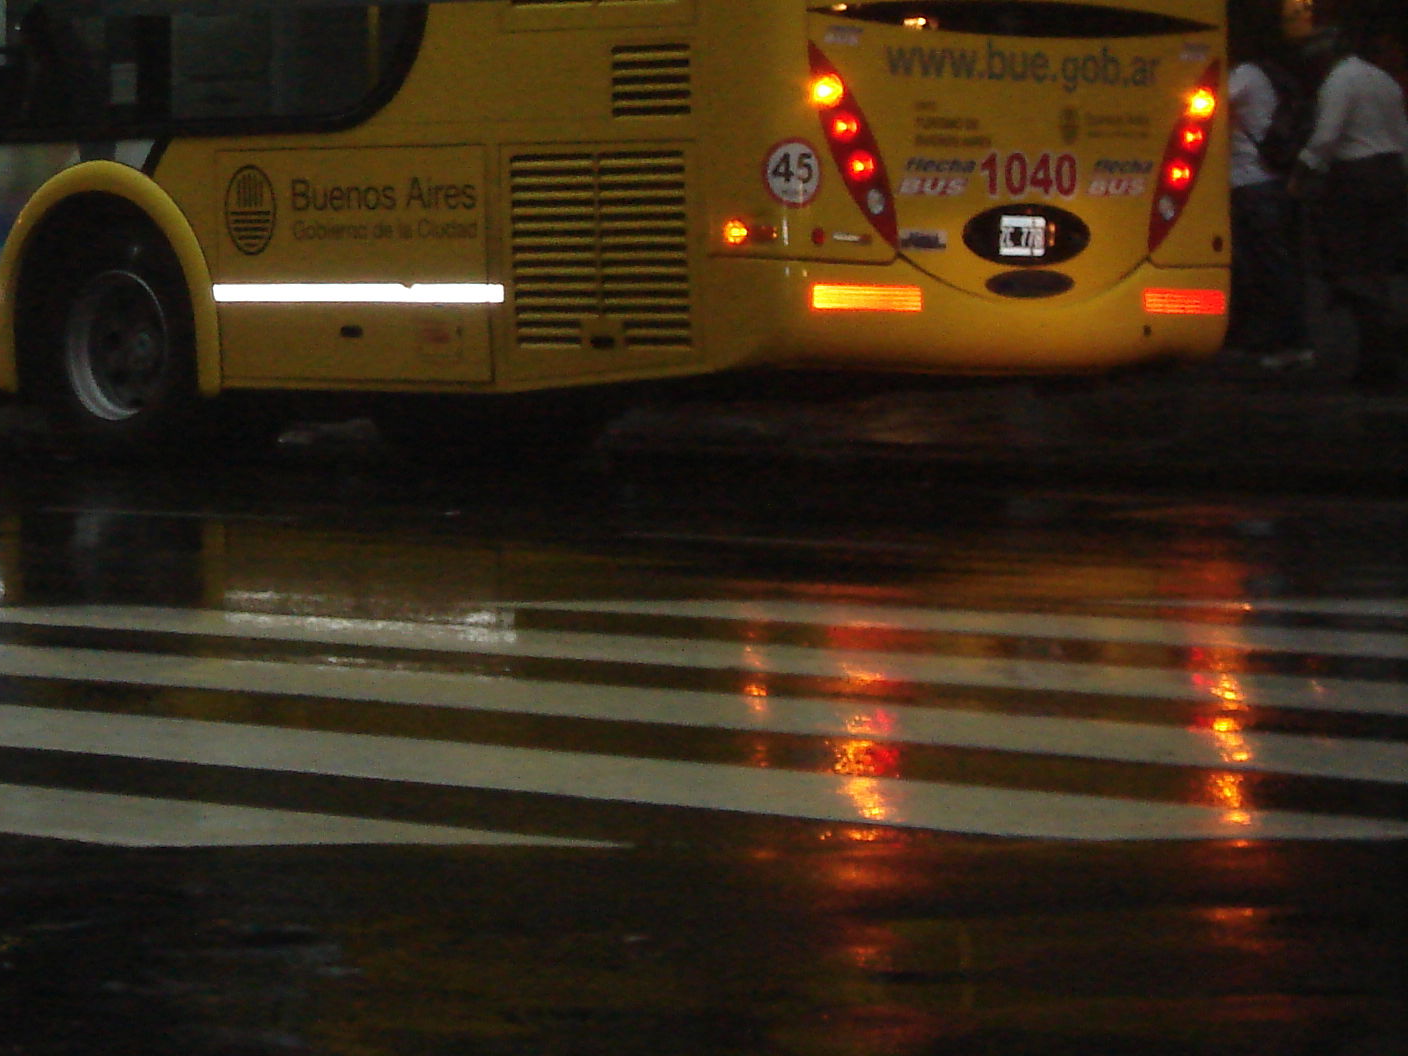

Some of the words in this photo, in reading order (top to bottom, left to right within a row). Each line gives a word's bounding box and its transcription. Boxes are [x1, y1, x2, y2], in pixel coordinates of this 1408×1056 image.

[886, 42, 1160, 93] www.bue.gob.ar
[772, 153, 813, 184] 45
[981, 152, 1077, 197] 1040
[291, 178, 397, 210] Buenos
[407, 177, 477, 209] Aires
[293, 219, 368, 240] Gobierno
[373, 219, 393, 239] de
[417, 218, 478, 239] Ciudad
